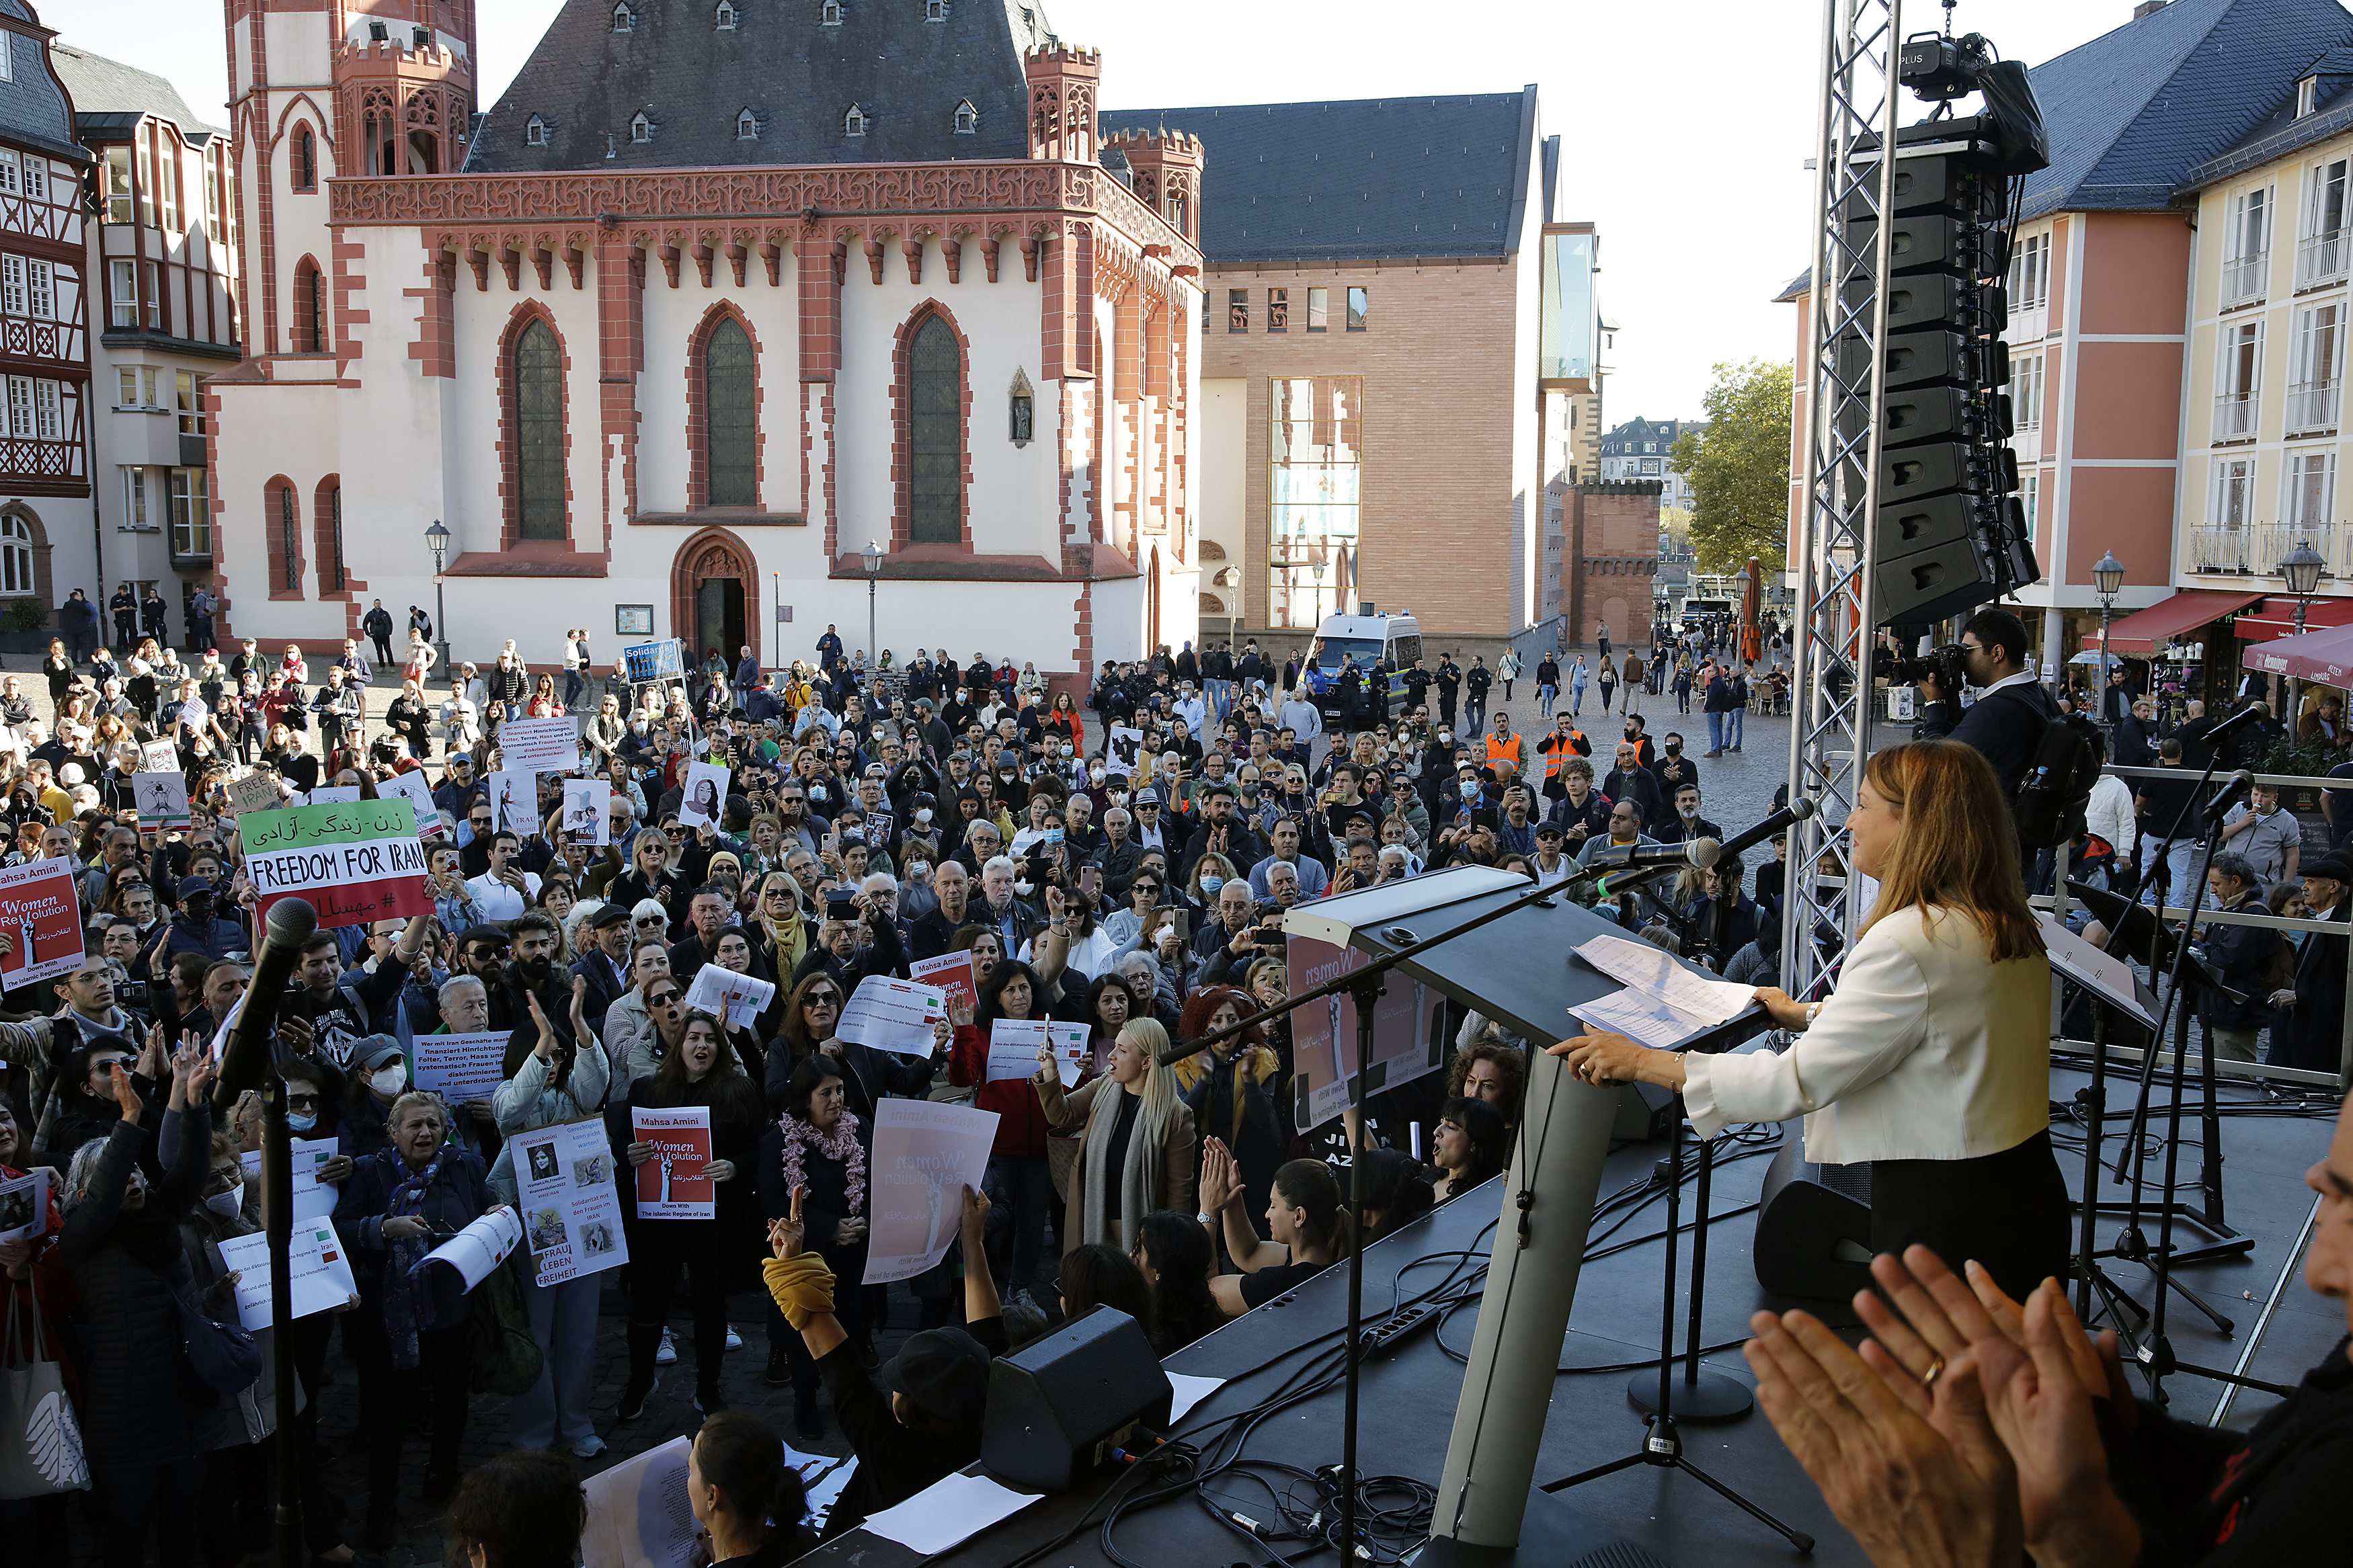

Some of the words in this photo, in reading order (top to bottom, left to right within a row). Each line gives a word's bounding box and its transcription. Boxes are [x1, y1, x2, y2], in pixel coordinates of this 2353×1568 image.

[626, 643, 672, 657] Solidarität
[2264, 654, 2288, 672] Henninger
[2310, 671, 2330, 682] LIMBURG
[2328, 665, 2342, 676] ALTEN
[237, 776, 268, 794] FREE
[242, 786, 273, 807] IRAN
[252, 851, 339, 887] FREEDOM
[344, 846, 385, 877] FOR
[389, 842, 426, 872] IRAN
[0, 872, 26, 885] ahsa
[29, 864, 59, 878] Amini
[2, 895, 58, 915] Women
[28, 964, 43, 973] Down
[918, 962, 941, 973] Mahsa
[943, 956, 963, 966] Amini
[7, 979, 18, 987] The
[19, 974, 39, 985] Islamic
[40, 968, 62, 979] Regime
[70, 962, 81, 970] Iran
[889, 985, 912, 993] Deutschland
[863, 997, 885, 1005] diktatorische
[869, 1013, 892, 1022] Atombomben
[448, 1069, 500, 1077] diskriminieren
[567, 1120, 602, 1133] Gerechtigkeit
[641, 1118, 670, 1126] Mahsa
[520, 1133, 558, 1147] #MahsaAmini
[573, 1131, 586, 1141] kann
[587, 1130, 600, 1139] nicht
[577, 1140, 599, 1149] warten!
[648, 1139, 694, 1151] Women
[527, 1176, 566, 1189] Woman,Life,Freedom
[303, 1186, 321, 1194] Menschheit
[538, 1191, 549, 1199] #FREE
[571, 1196, 600, 1207] Solidarität
[600, 1193, 609, 1201] mit
[573, 1208, 584, 1216] den
[585, 1203, 602, 1214] Frauen
[603, 1201, 610, 1209] im
[308, 1225, 321, 1233] wissen,
[227, 1245, 242, 1253] Europa,
[243, 1240, 266, 1249] insbesonder
[296, 1250, 311, 1260] Regime
[321, 1243, 333, 1251] Iran
[545, 1245, 571, 1260] FRAU
[543, 1256, 571, 1272] LEBEN
[307, 1266, 329, 1276] Menschheit
[539, 1268, 577, 1285] FREIHEIT
[245, 1299, 267, 1311] gefährlich
